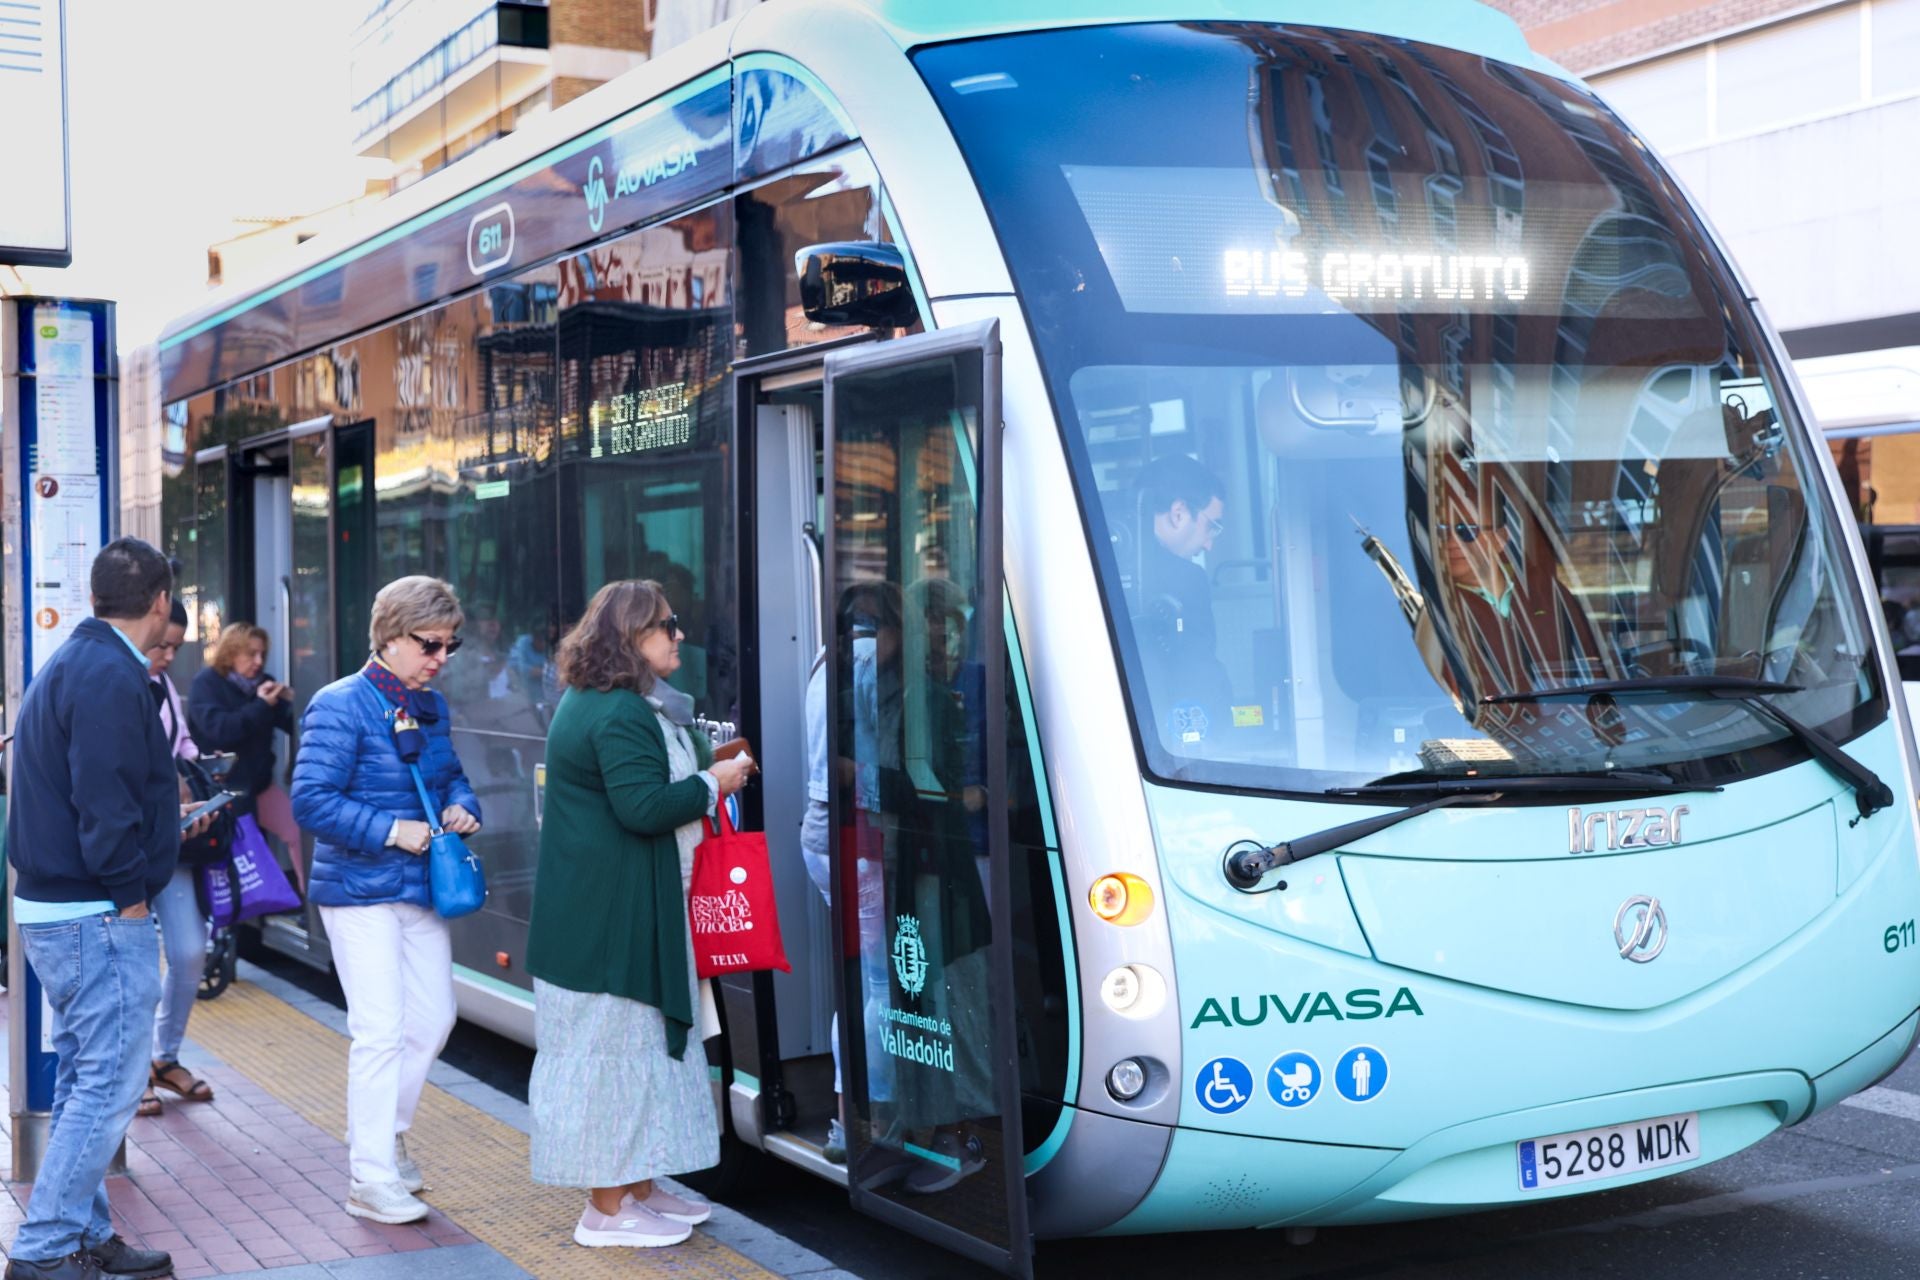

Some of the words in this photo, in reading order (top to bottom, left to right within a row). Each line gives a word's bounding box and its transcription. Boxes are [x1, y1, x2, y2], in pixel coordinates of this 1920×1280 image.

[614, 146, 698, 200] AUVASA
[478, 223, 503, 255] 611
[1225, 250, 1308, 296] BUS
[1322, 253, 1529, 300] GRATUITO
[611, 424, 633, 455] BUS
[634, 413, 690, 451] GRATUITO
[42, 480, 52, 494] 7
[1568, 804, 1690, 854] Irizar
[730, 904, 752, 920] DE
[1884, 918, 1915, 953] 611
[710, 952, 749, 966] TELVA
[878, 1002, 938, 1032] Ayuntamiento
[939, 1018, 952, 1036] de
[1190, 987, 1424, 1029] AUVASA
[879, 1025, 954, 1072] Valladolid
[1542, 1133, 1625, 1180] 5288
[1636, 1118, 1691, 1164] MDK
[1526, 1169, 1533, 1181] E
